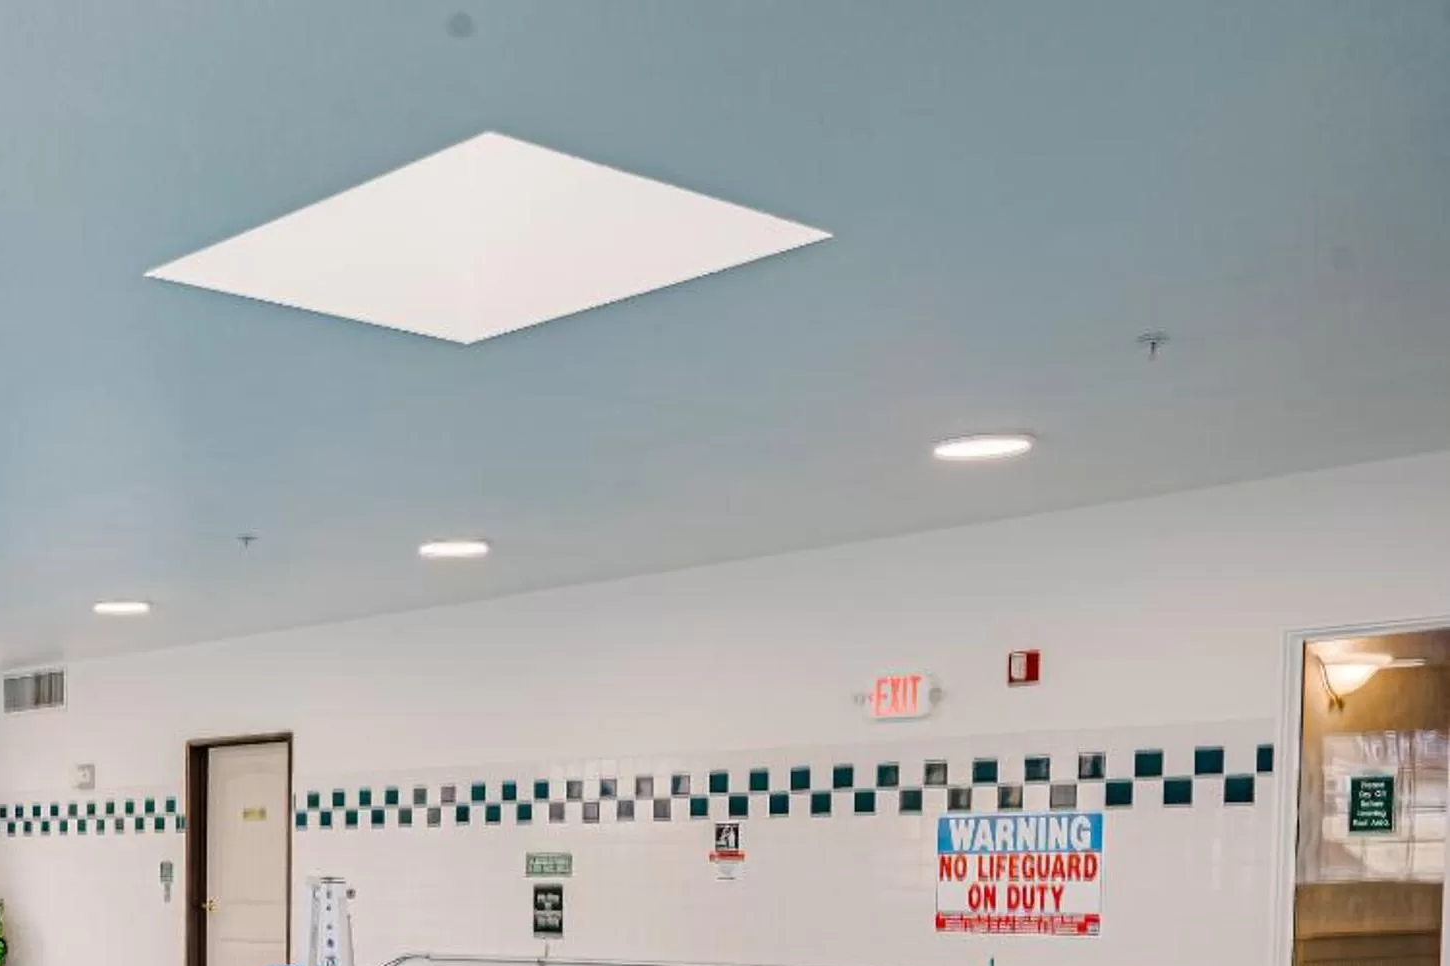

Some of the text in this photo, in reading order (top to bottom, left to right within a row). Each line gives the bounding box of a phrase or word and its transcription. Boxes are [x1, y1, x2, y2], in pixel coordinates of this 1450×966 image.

[875, 675, 922, 716] EXIT
[950, 815, 1091, 851] WARNING
[939, 851, 1098, 881] NO LIFEGUARD
[968, 884, 1064, 911] ON DUTY
